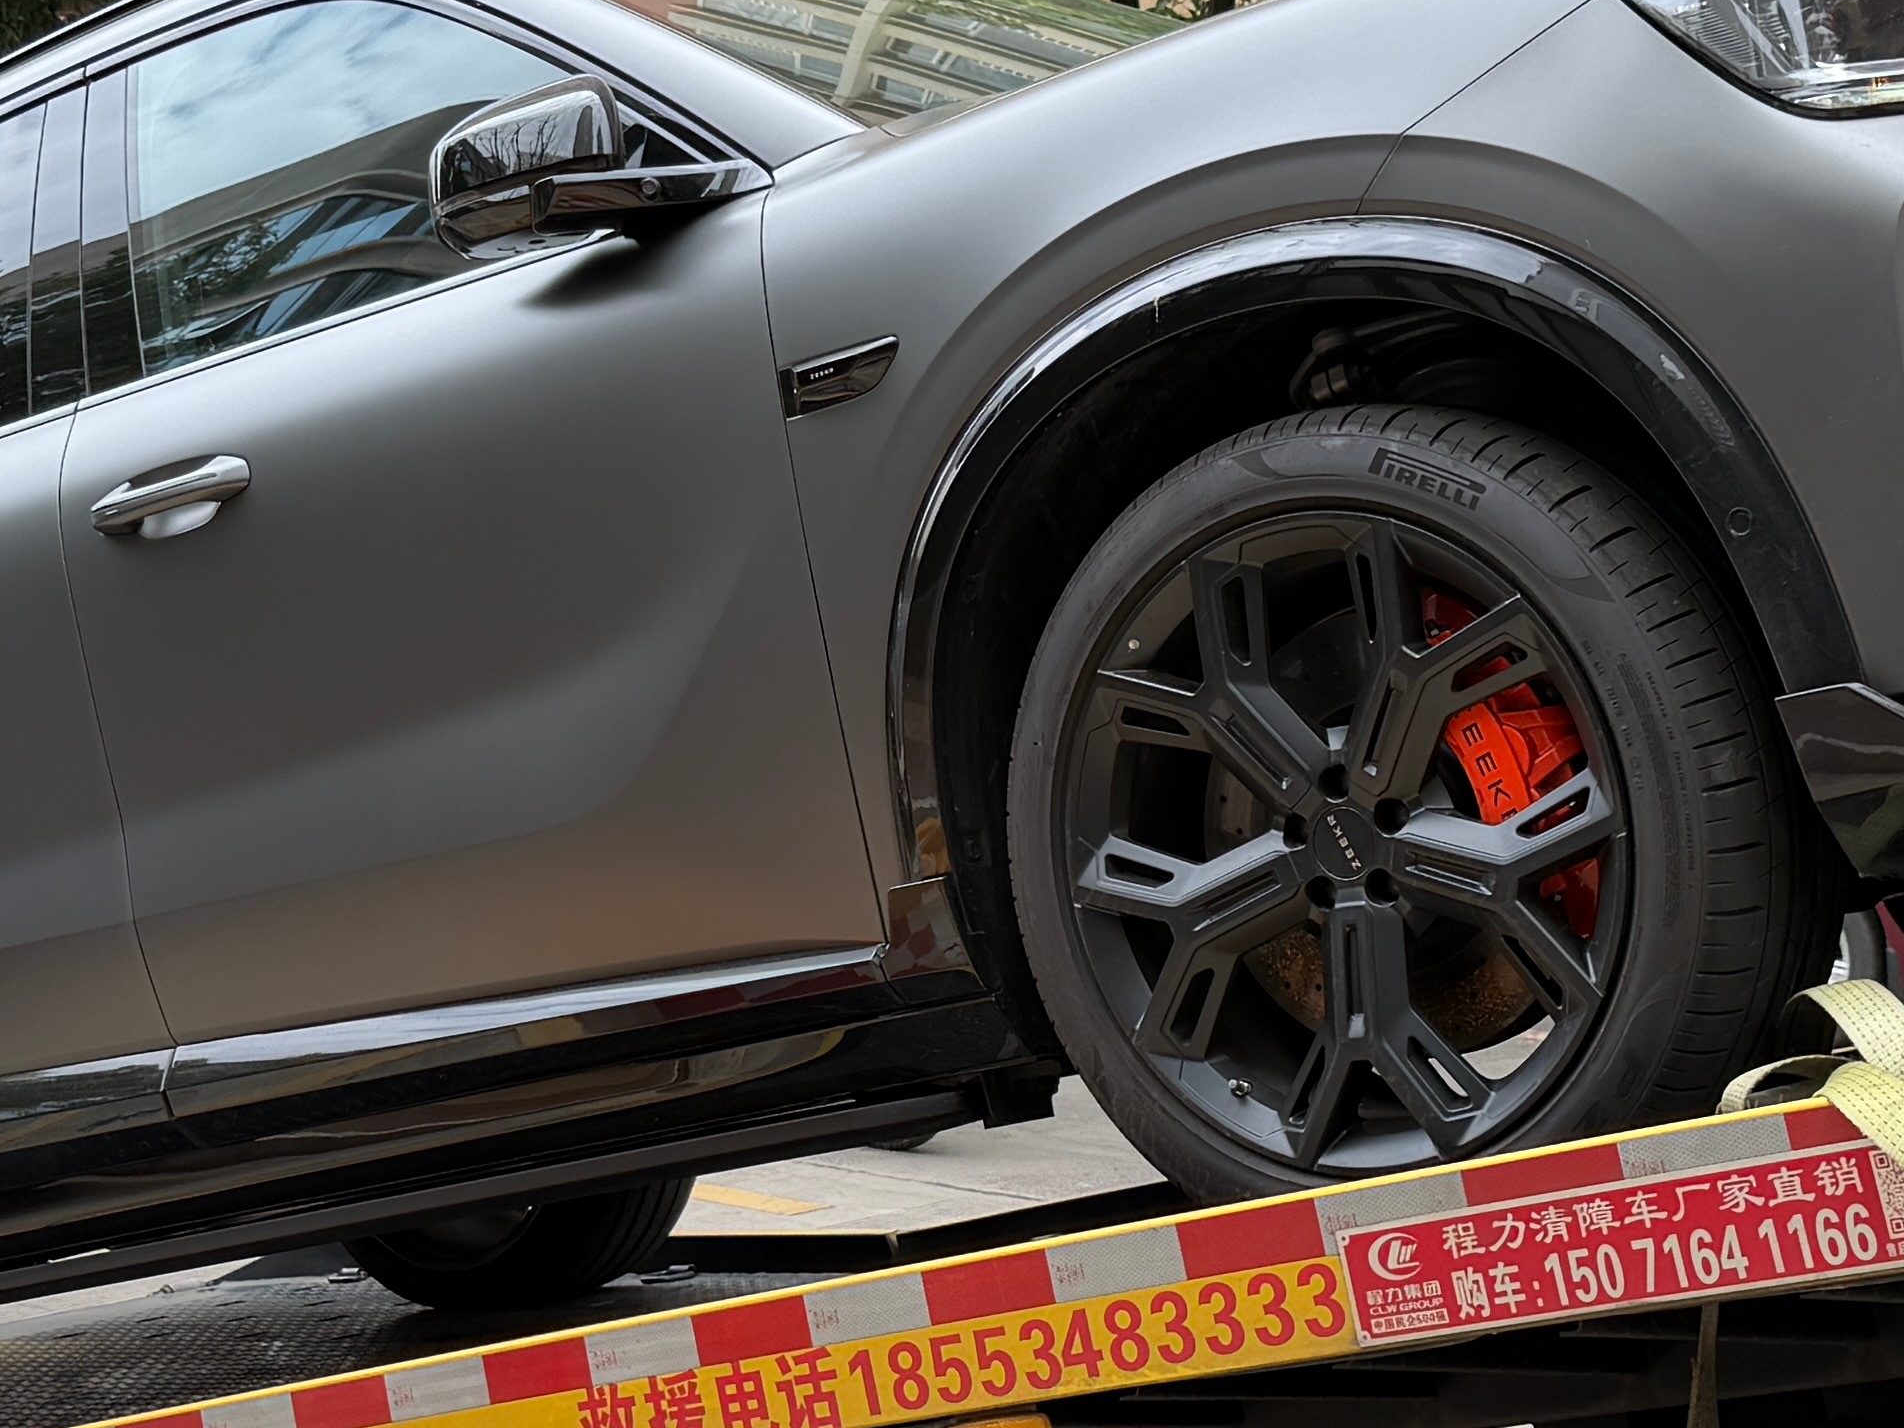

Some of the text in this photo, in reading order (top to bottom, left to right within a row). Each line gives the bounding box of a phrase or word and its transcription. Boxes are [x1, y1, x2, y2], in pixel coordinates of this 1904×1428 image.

[1367, 447, 1487, 511] PIRELLI
[1441, 1157, 1865, 1260] 程力清障车厂家直销
[1642, 1226, 1749, 1295] 7164
[1758, 1203, 1879, 1276] 1166
[1399, 1297, 1444, 1312] GROUP
